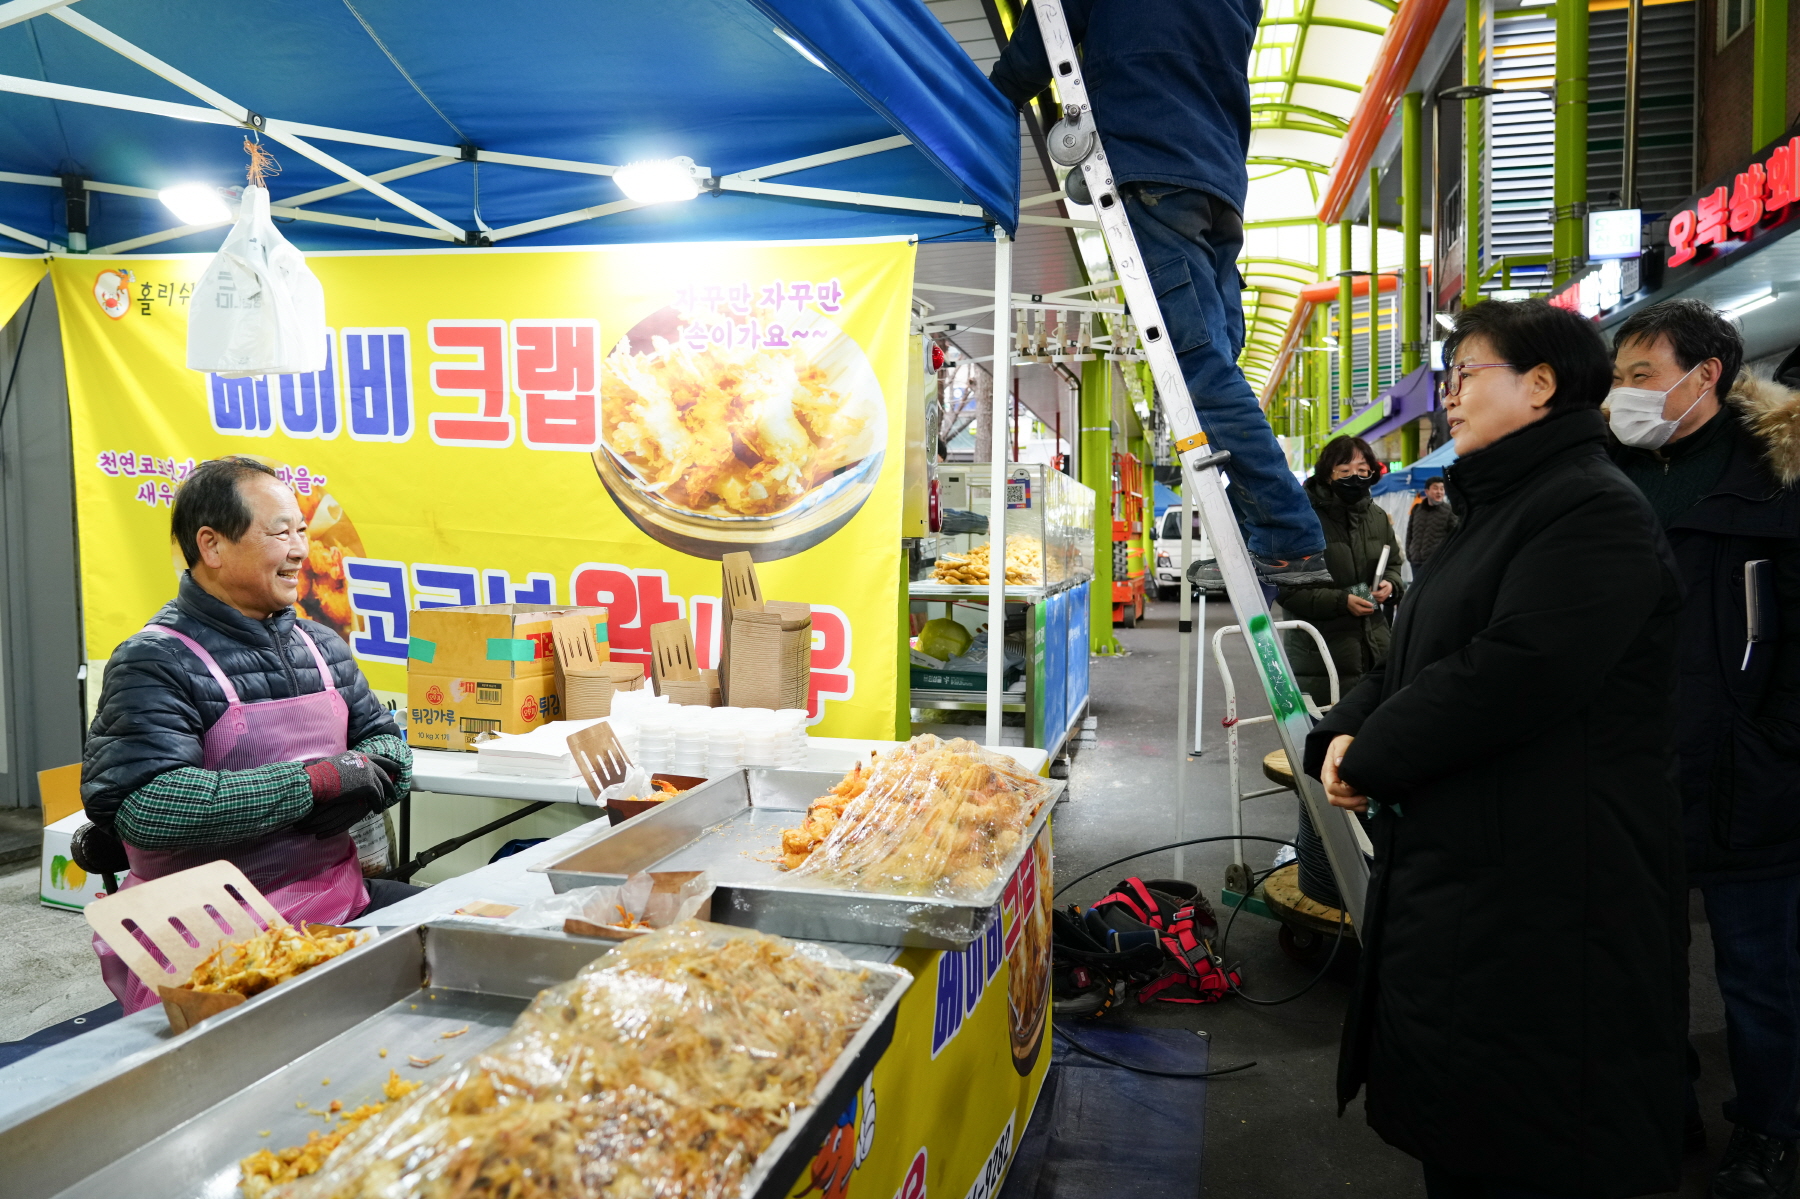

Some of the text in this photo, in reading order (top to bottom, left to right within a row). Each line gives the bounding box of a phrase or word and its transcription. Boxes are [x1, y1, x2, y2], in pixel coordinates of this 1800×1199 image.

[1667, 135, 1800, 268] 오복상회
[675, 281, 841, 313] 자꾸만 자꾸만
[430, 323, 597, 448] 크랩
[412, 708, 456, 726] 튀김가루
[426, 732, 434, 740] kg
